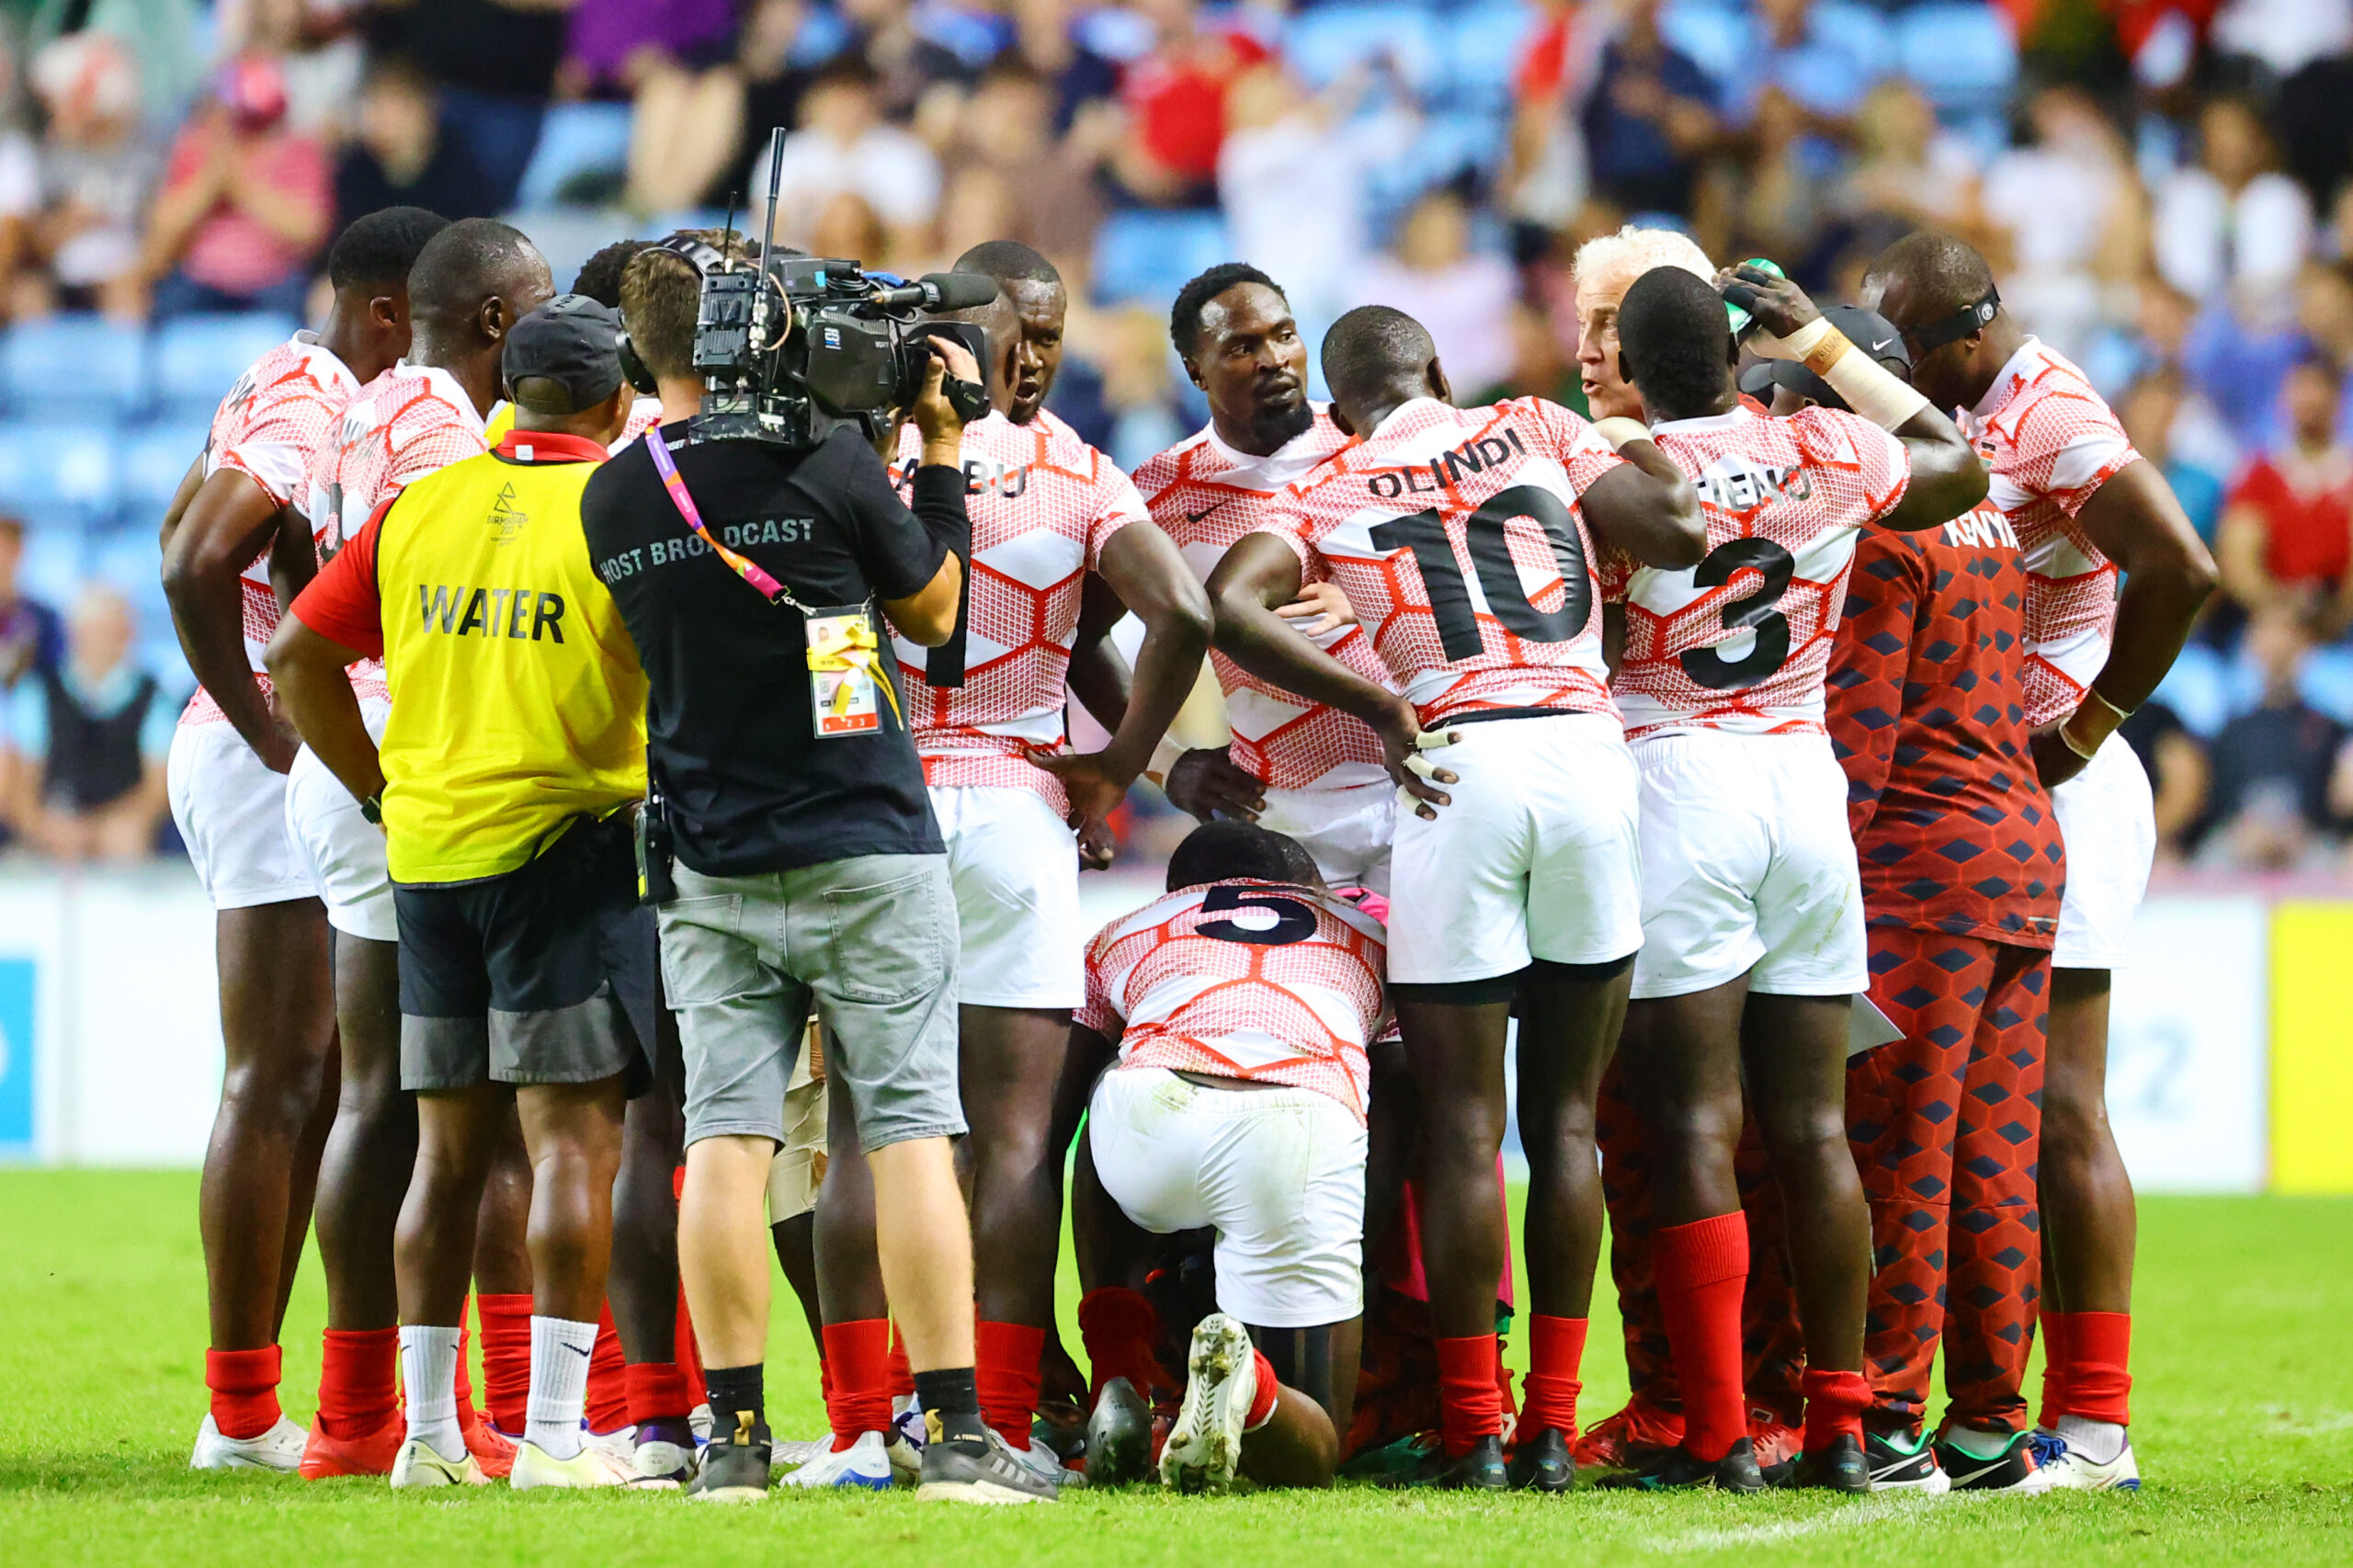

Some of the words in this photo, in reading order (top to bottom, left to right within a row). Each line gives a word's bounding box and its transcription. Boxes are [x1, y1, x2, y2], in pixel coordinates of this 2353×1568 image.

[1369, 427, 1526, 498] OLINDI
[1698, 464, 1812, 512] IENO
[599, 549, 643, 585] HOST
[649, 518, 815, 566] BRODCAST
[1368, 484, 1593, 663] 10
[419, 584, 565, 644] WATER
[1679, 537, 1795, 689] 3
[847, 719, 853, 728] 2
[1194, 885, 1317, 946] 5
